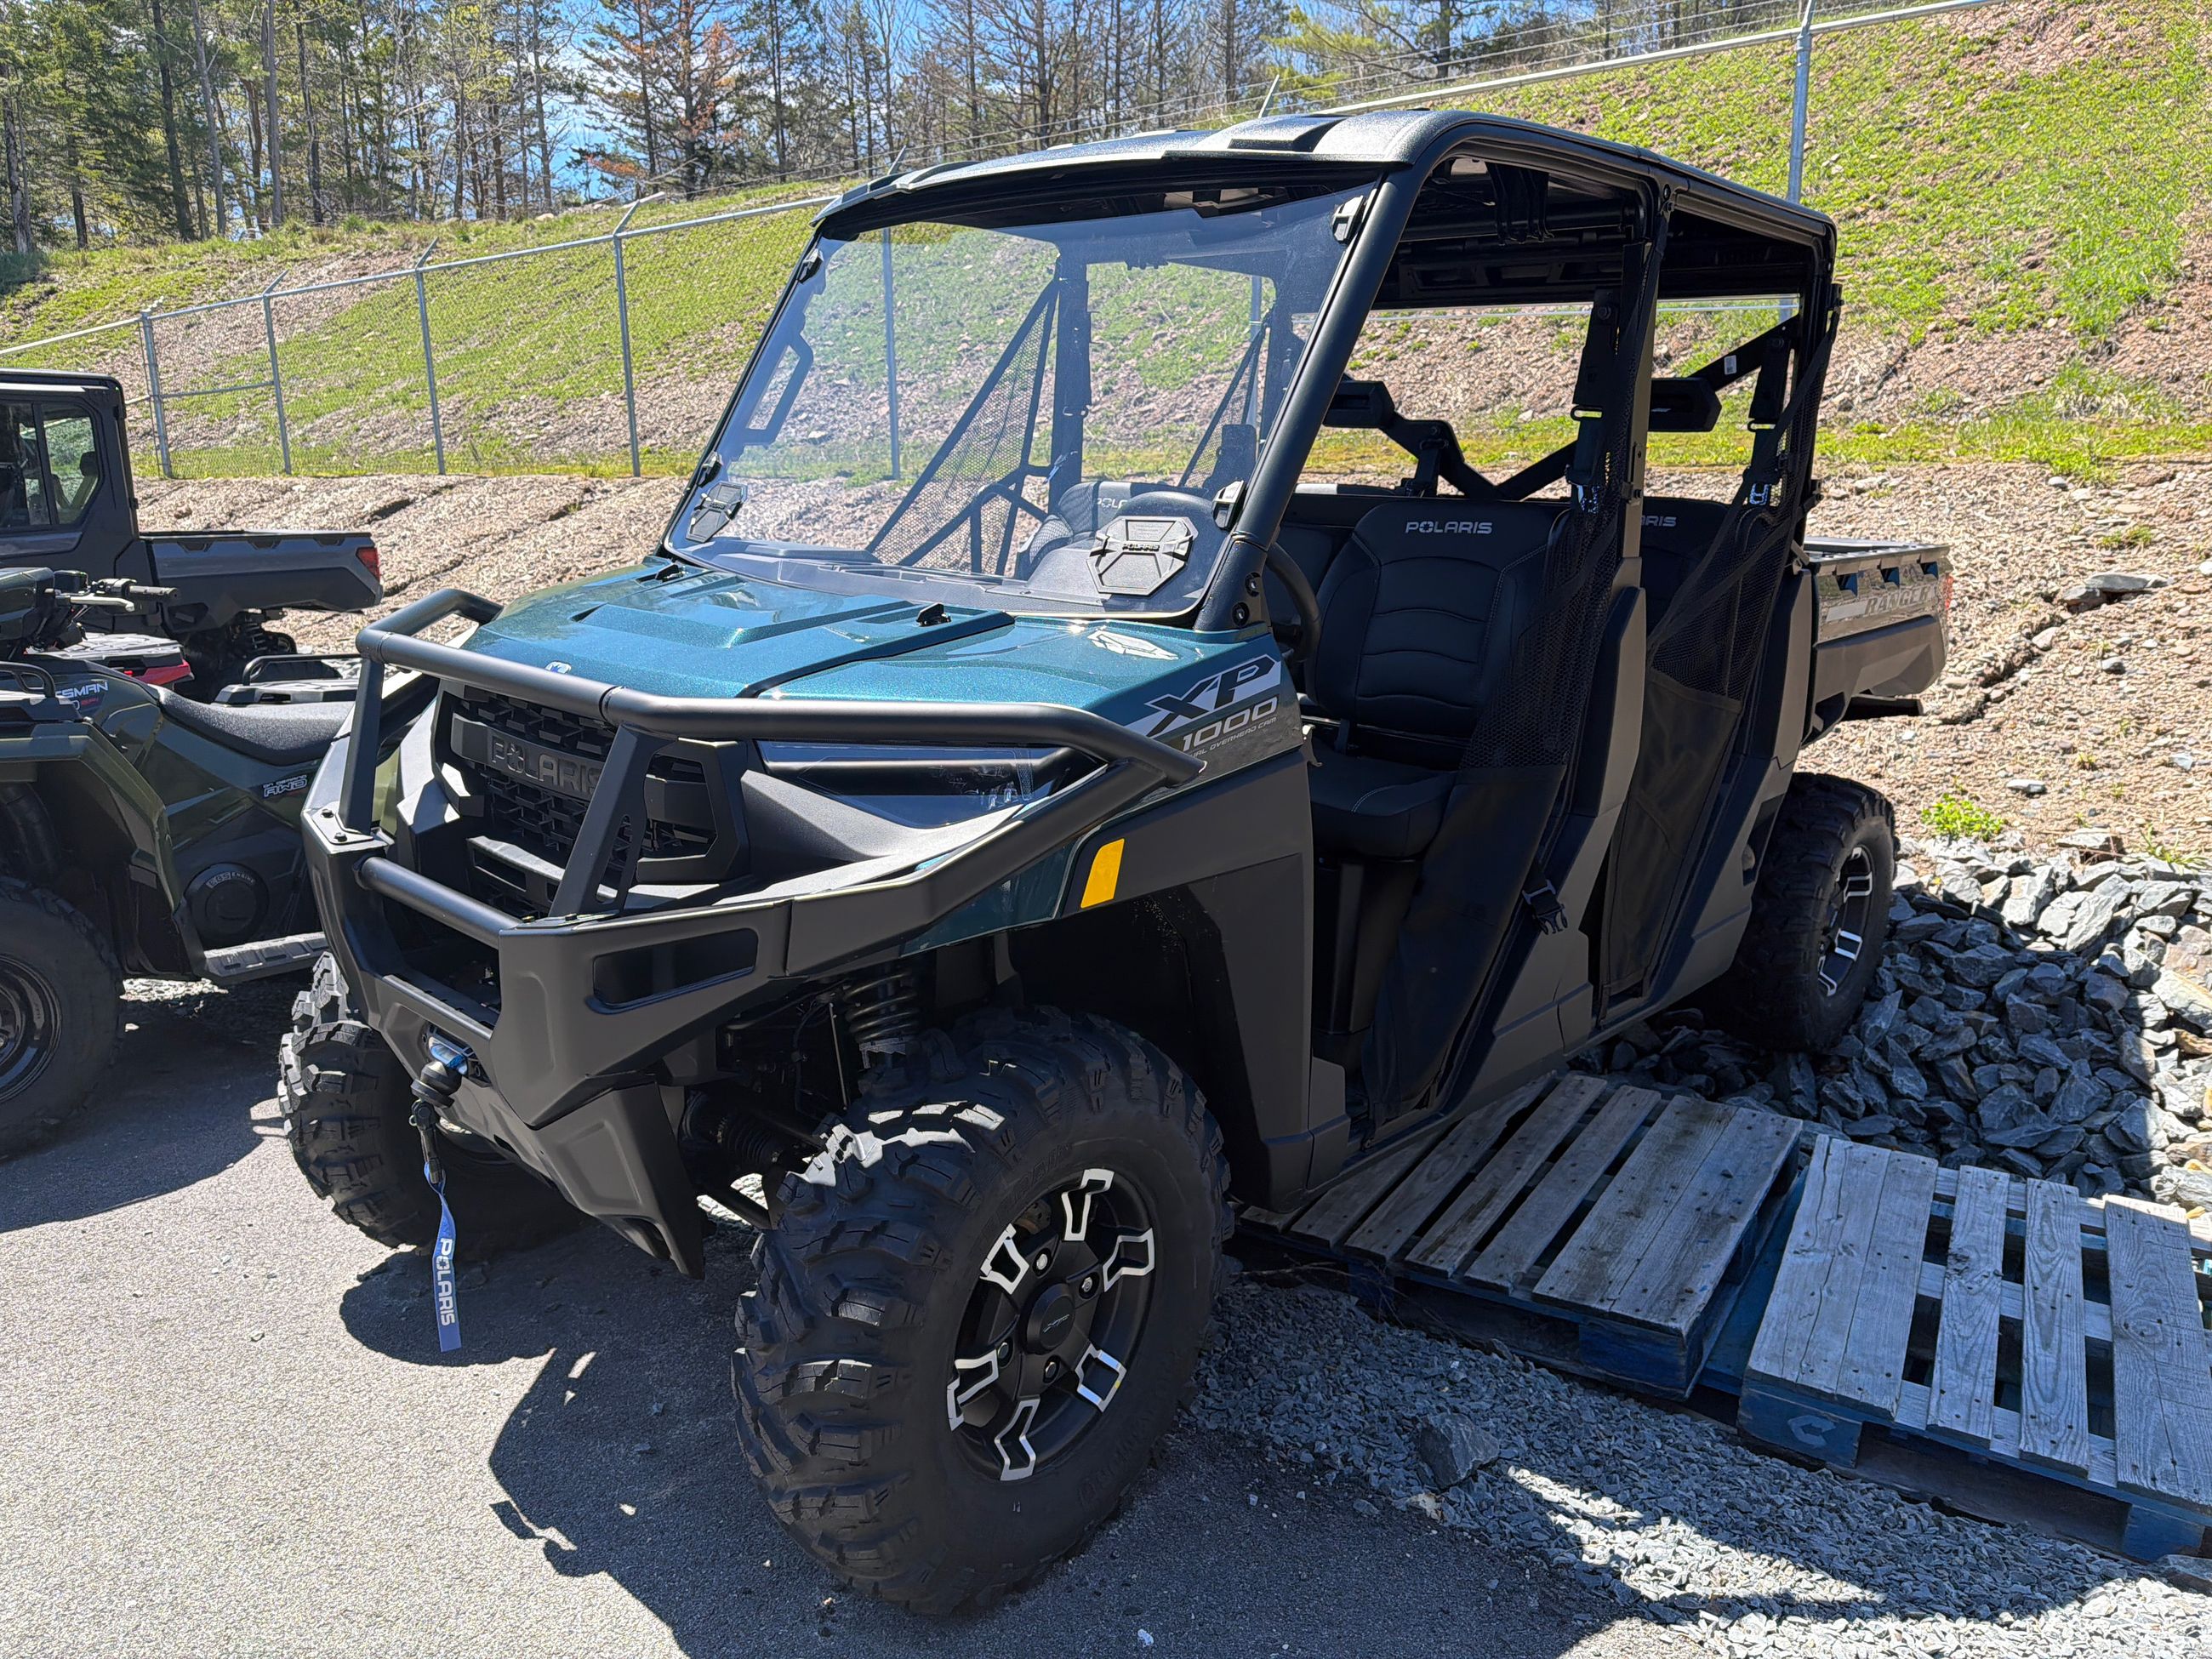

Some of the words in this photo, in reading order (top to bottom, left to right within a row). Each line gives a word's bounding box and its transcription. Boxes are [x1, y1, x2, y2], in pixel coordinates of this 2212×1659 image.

[1405, 521, 1492, 534] POLARIS
[1863, 585, 1930, 616] RANGER
[1143, 653, 1276, 738] XP
[1182, 696, 1278, 752] 1000
[1210, 726, 1257, 750] OVERHEAD
[1257, 717, 1277, 729] CAM
[264, 778, 308, 797] AWD
[436, 1238, 455, 1325] POLARIS
